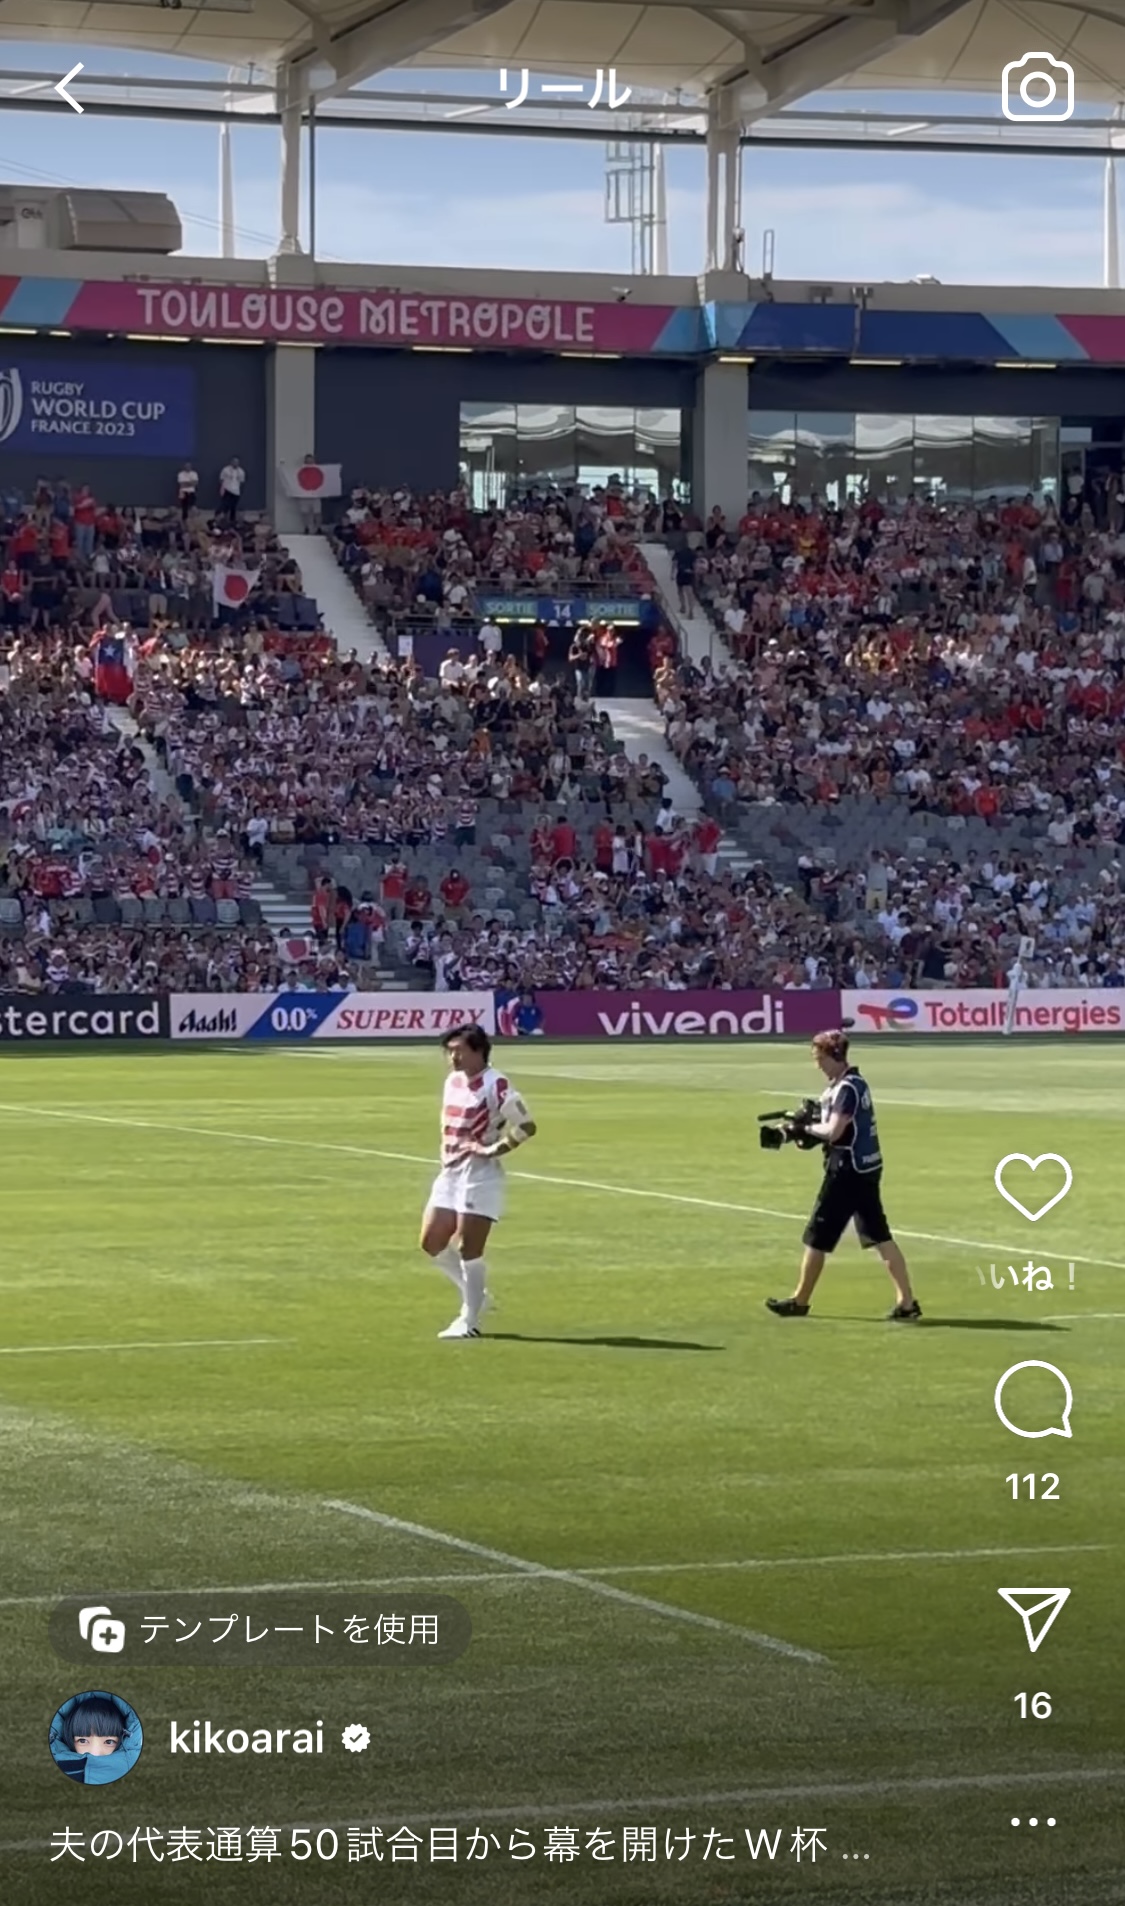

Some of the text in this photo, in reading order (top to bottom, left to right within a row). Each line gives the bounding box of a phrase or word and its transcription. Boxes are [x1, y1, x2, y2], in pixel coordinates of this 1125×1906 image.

[359, 297, 595, 342] METROPOLE
[31, 380, 84, 396] RUGBY
[32, 398, 166, 420] WORLD CUP
[31, 419, 136, 437] FRANCE 2023
[553, 604, 572, 619] 14
[0, 1001, 159, 1036] tercard
[336, 1008, 425, 1031] SUPER
[430, 1008, 486, 1031] TRY
[597, 994, 785, 1035] vivendi
